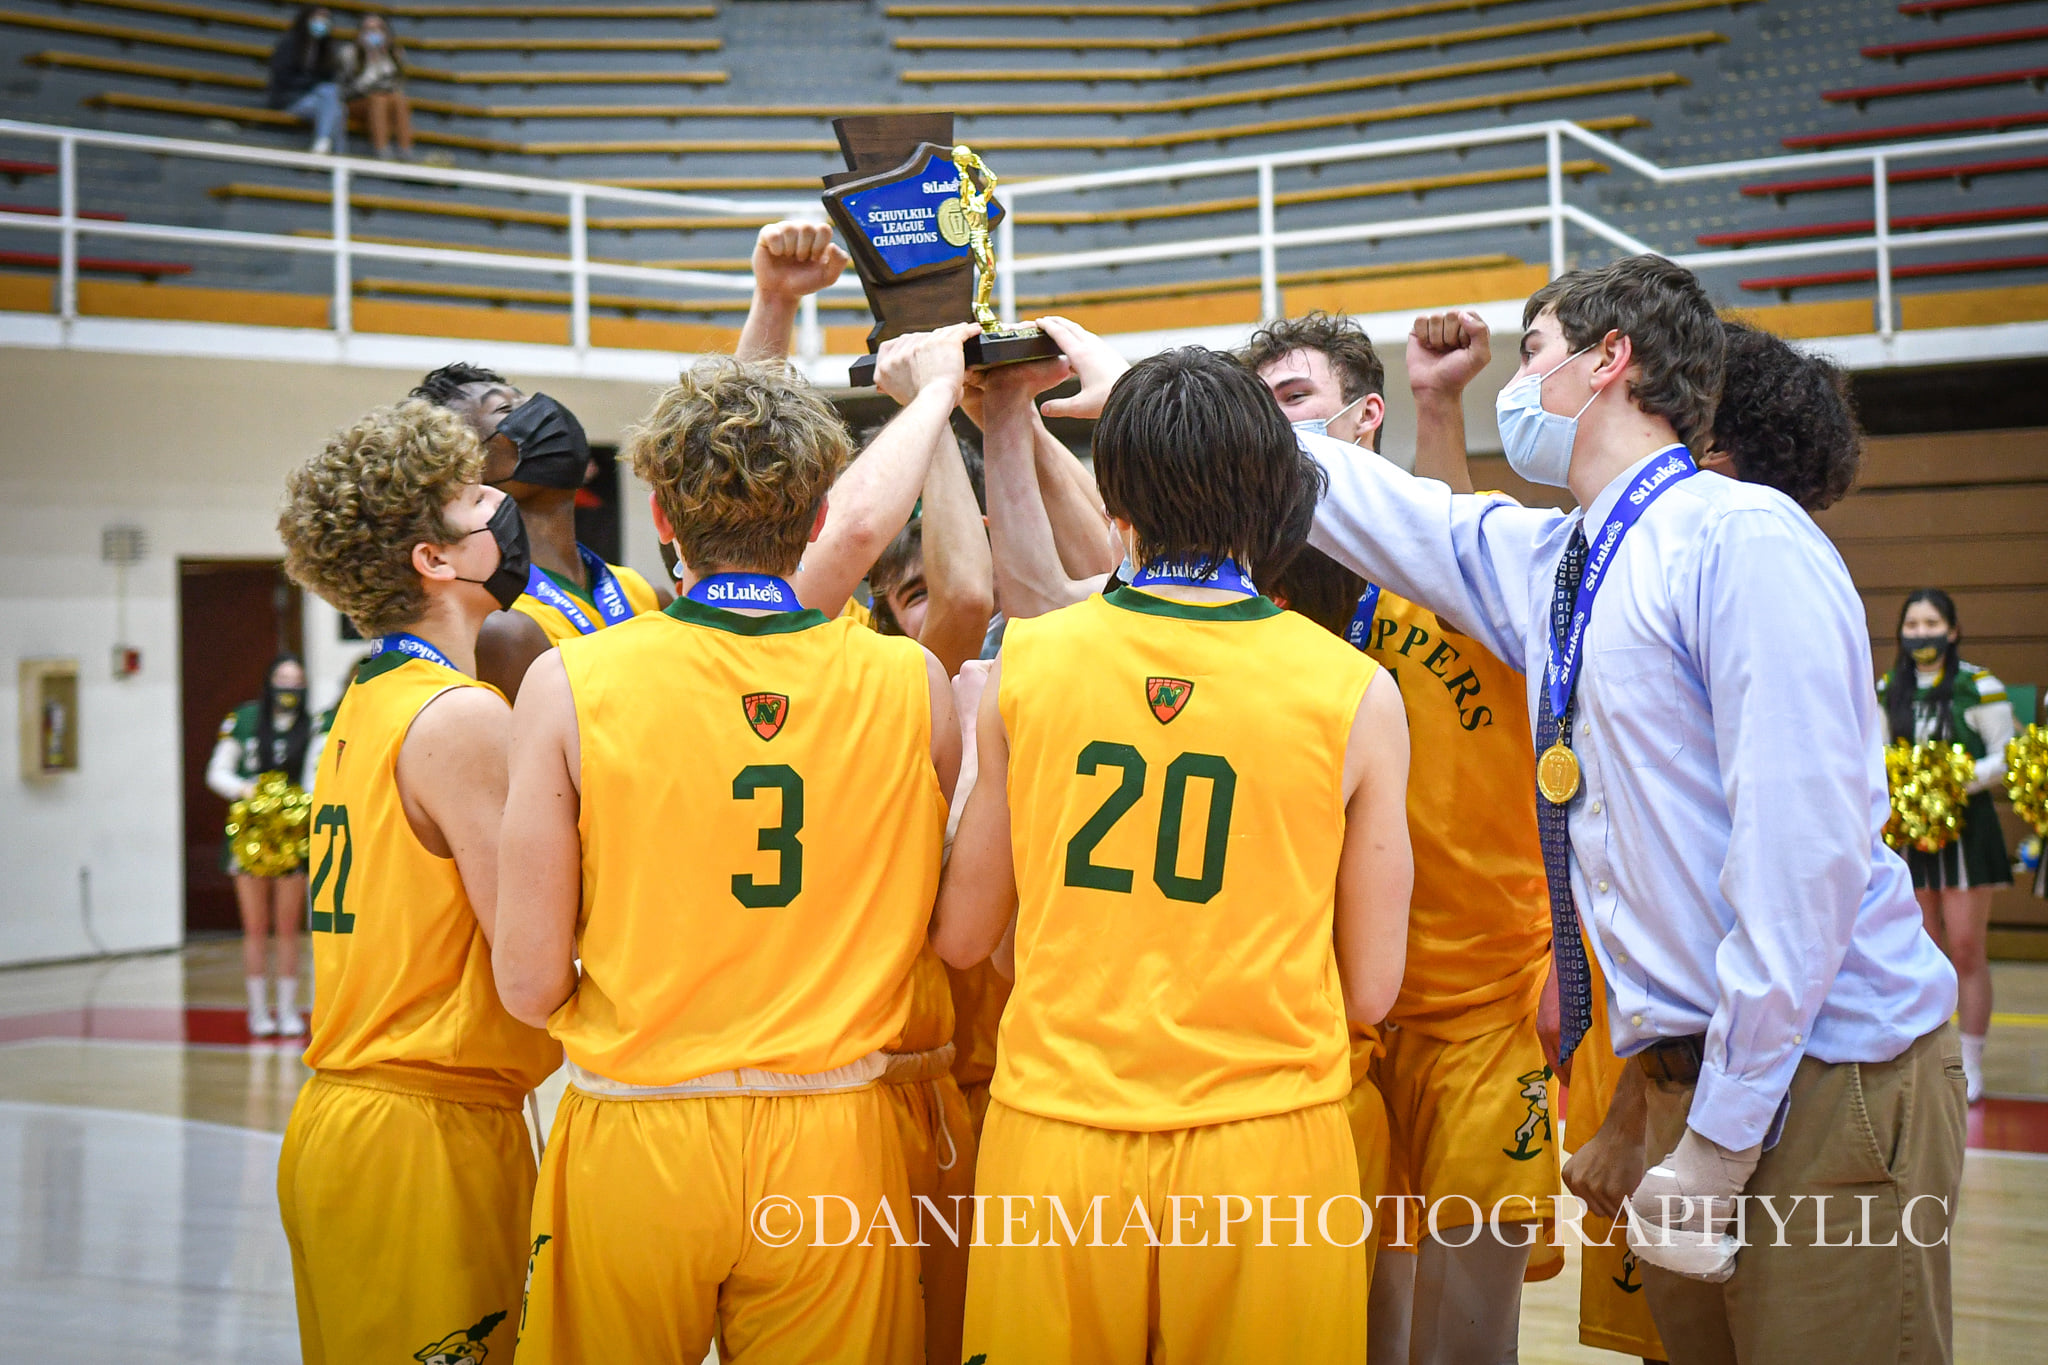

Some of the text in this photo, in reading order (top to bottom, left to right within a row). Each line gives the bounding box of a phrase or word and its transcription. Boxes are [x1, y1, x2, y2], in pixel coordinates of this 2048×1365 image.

[867, 208, 936, 222] SCHUYLKILL
[873, 232, 938, 247] CHAMPIONS
[882, 221, 925, 234] LEAGUE
[731, 764, 804, 909] 3
[1064, 740, 1238, 905] 20
[312, 804, 356, 934] 22
